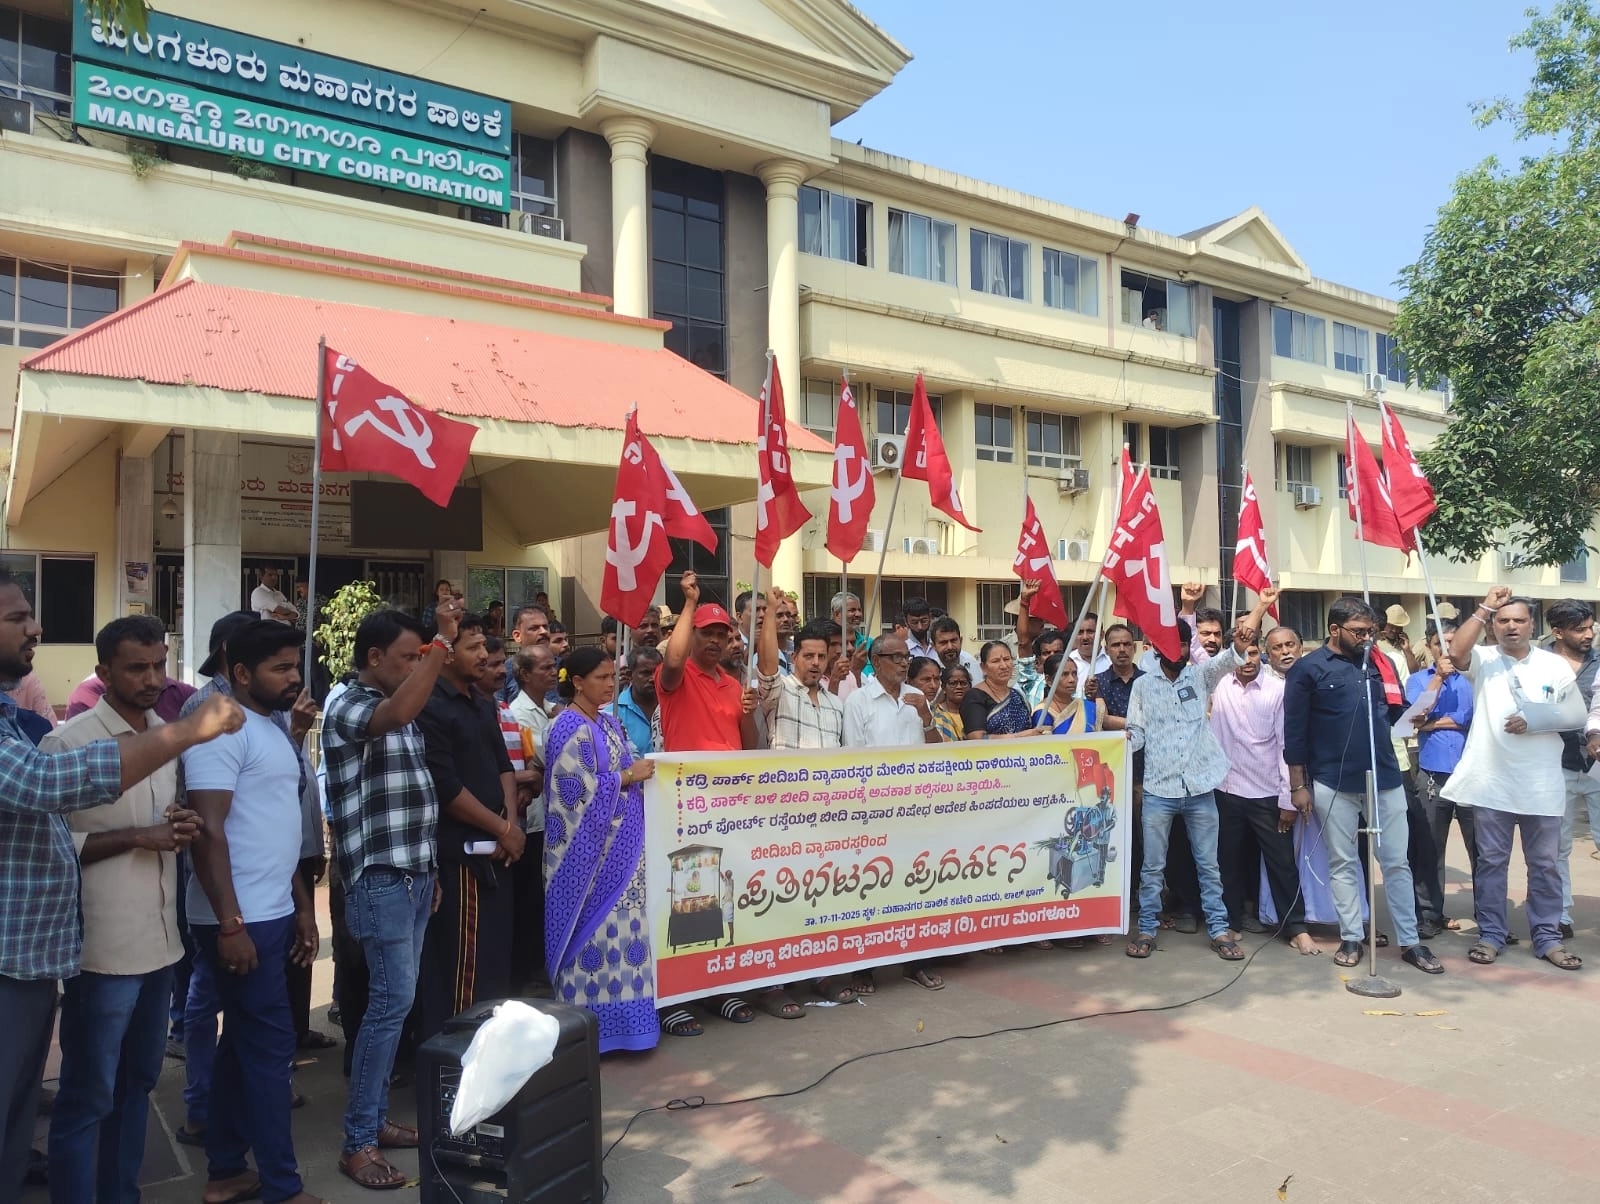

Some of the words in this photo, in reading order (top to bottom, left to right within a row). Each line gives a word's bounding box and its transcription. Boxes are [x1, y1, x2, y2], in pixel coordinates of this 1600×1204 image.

[91, 18, 267, 83] ಮಂಗಳೂರು
[279, 61, 417, 118] ಮಹಾನಗರ
[427, 100, 502, 138] ಪಾಲಿಕೆ
[88, 102, 265, 156] MANGALURU
[274, 143, 331, 170] CITY
[338, 157, 503, 206] CORPORATION
[278, 478, 350, 497] ಮಹಾನಗ
[685, 774, 708, 790] ಕದ್ರಿ
[758, 768, 809, 784] ಬೀದಿಬದಿ
[812, 765, 873, 786] ವ್ಯಾಪಾರಸ್ಥರ
[877, 762, 915, 777] ಮೇಲಿನ
[687, 797, 708, 813] ಕದ್ರಿ
[754, 792, 778, 805] ಬಳಿ
[780, 790, 809, 804] ಬೀದಿ
[813, 786, 867, 806] ವ್ಯಾಪಾರಕ್ಕೆ
[869, 785, 911, 799] ಅವಕಾಶ
[914, 782, 953, 799] ಕಲ್ಪಿಸಲು
[687, 820, 713, 837] ಏರ್
[769, 810, 818, 831] ರಸ್ತೆಯಲ್ಲಿ
[820, 807, 848, 823] ಬೀದಿ
[851, 806, 894, 826] ವ್ಯಾಪಾರ
[896, 804, 931, 819] ನಿಷೇಧ
[934, 801, 967, 815] ಆದೇಶ
[969, 796, 1030, 812] ಹಿಂಪಡೆಯಲು
[751, 841, 802, 861] ಬೀದಿಬದಿ
[805, 834, 888, 859] ವ್ಯಾಪಾರಸ್ಥರಿಂದ
[737, 855, 894, 917] ಪ್ರತಿಭಟನಾ
[904, 842, 1027, 894] ಪ್ರದರ್ಶನ
[820, 910, 861, 925] 17-11-2025
[882, 899, 923, 914] ಮಹಾನಗರ
[924, 897, 949, 909] ಪಾಲಿಕೆ
[739, 948, 776, 970] ಜಿಲ್ಲಾ
[778, 934, 839, 961] ಬೀದಿಬದಿ
[842, 925, 916, 954] ವ್ಯಾಪಾರಸ್ಥರ
[919, 918, 952, 938] ಸಂಘ
[981, 914, 1010, 930] CITU
[1012, 903, 1081, 925] ಮಂಗಳೂರು
